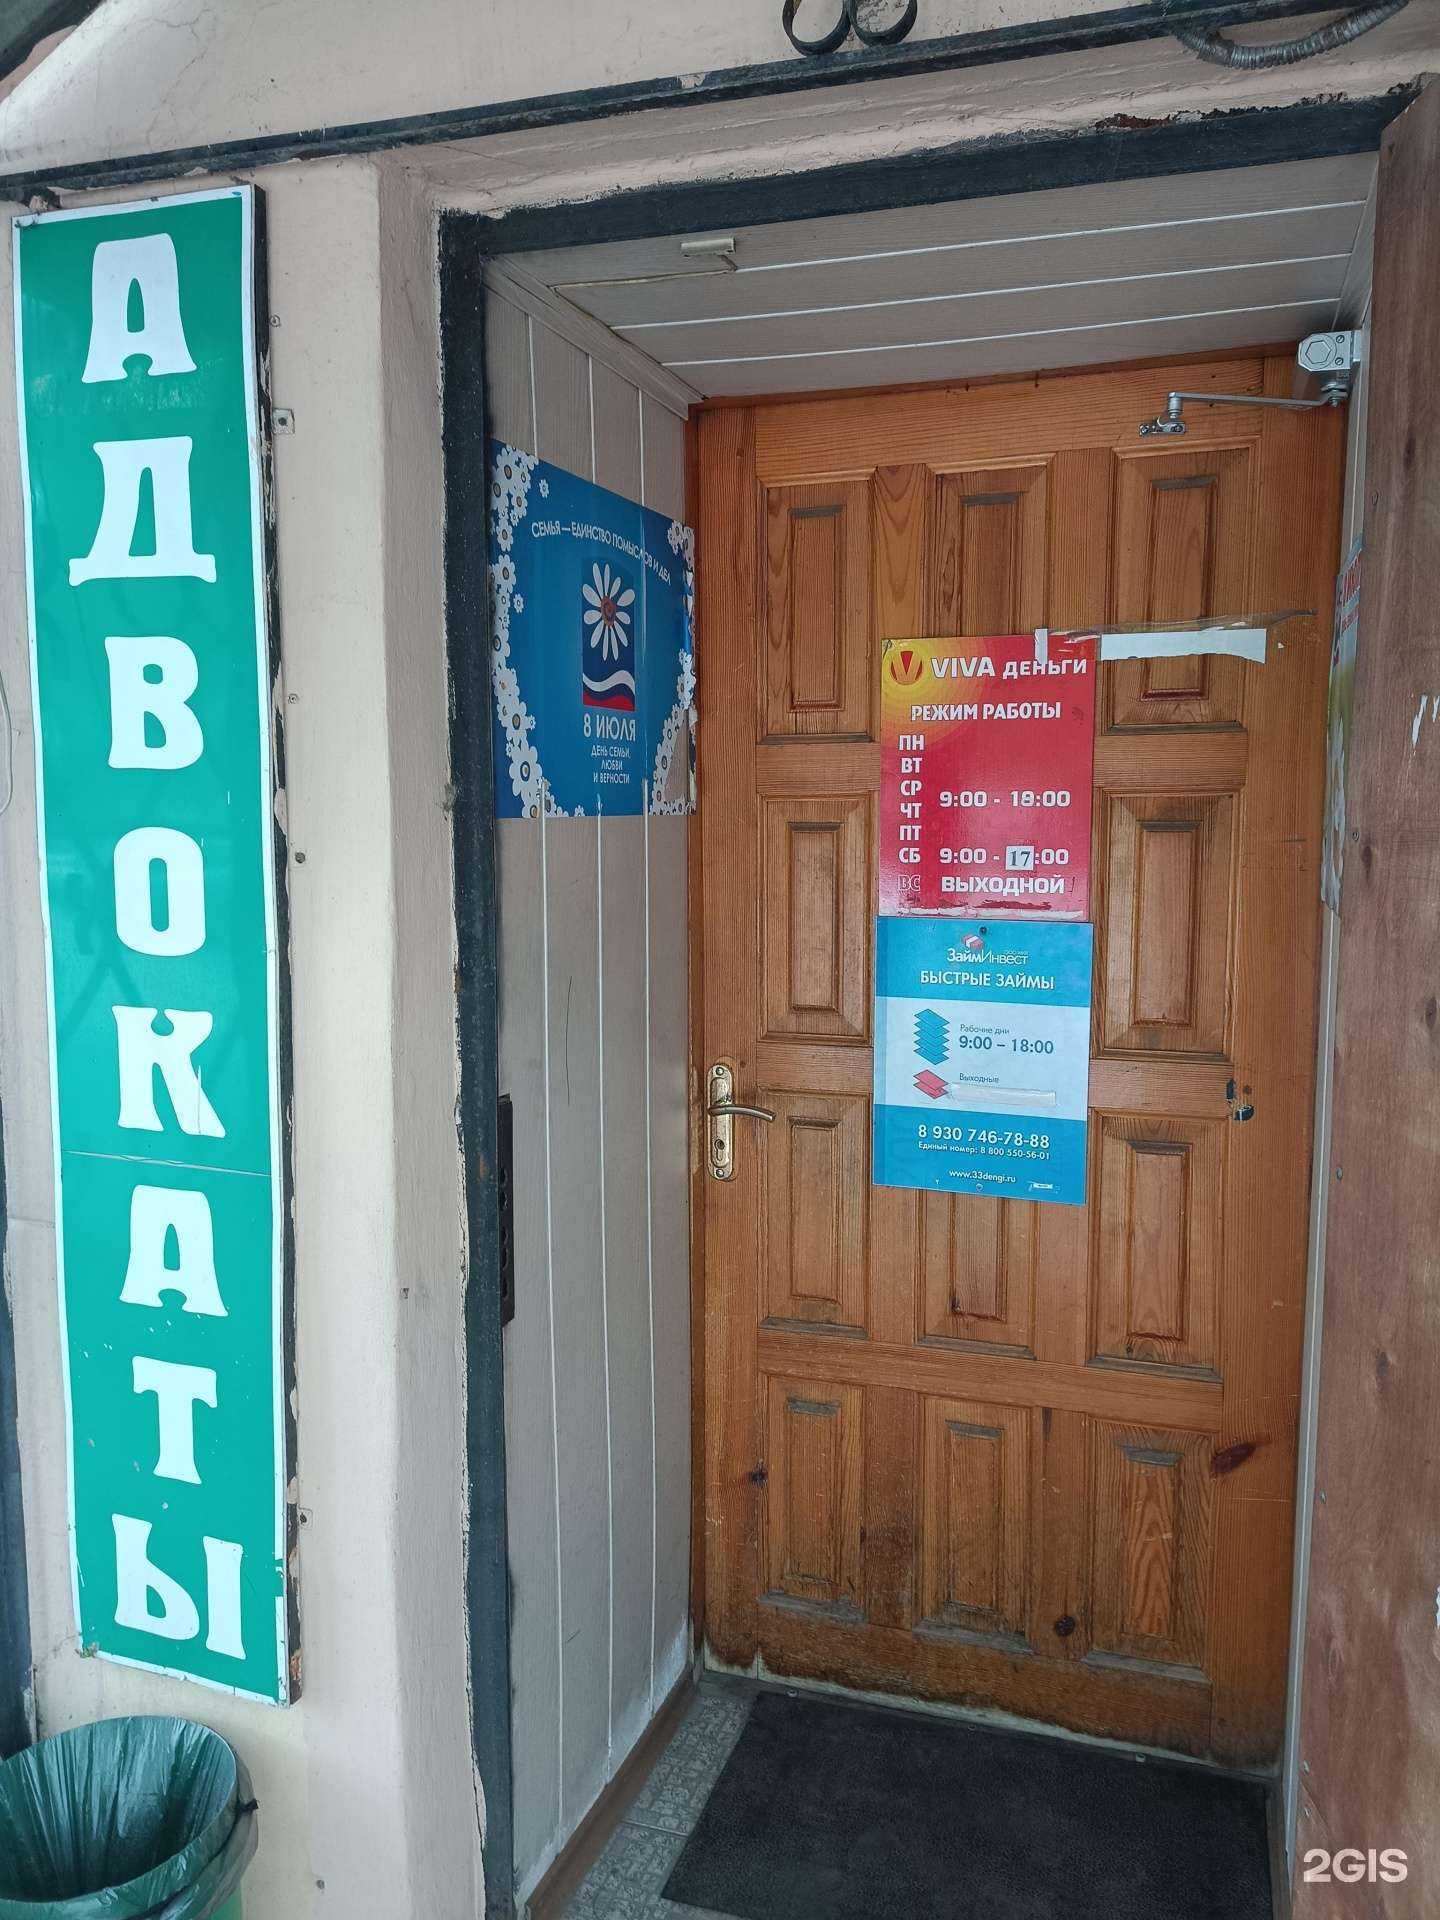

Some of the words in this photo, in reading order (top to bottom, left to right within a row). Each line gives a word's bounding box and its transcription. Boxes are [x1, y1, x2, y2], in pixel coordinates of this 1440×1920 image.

[531, 520, 561, 538] СЕМЬЯ
[571, 521, 613, 544] ЕДИНСТВО
[653, 558, 659, 573] И
[658, 565, 671, 586] ДЕЛ
[931, 656, 996, 678] VIVA
[911, 703, 978, 721] РЕЖИМ
[982, 701, 1061, 719] РАБОТЫ
[583, 713, 592, 738] 8
[596, 714, 636, 741] ИЮЛЯ
[898, 734, 925, 751] ПН
[591, 745, 608, 758] ДЕНЬ
[601, 760, 623, 771] ЛЮБВИ
[901, 757, 923, 774] ВТ
[593, 773, 598, 783] И
[600, 773, 630, 785] ВЕРНОСТИ
[900, 780, 922, 796] СР
[939, 790, 988, 807] 9:00
[900, 802, 922, 819] ЧТ
[899, 824, 922, 841] ПТ
[898, 847, 921, 864] СБ
[939, 847, 987, 864] 9:00
[1007, 848, 1069, 867] 17:00
[897, 874, 921, 892] ВС
[941, 874, 1065, 896] ВЫХОДНОЙ
[68, 232, 248, 1662] АДВОКАТЫ
[920, 970, 991, 986] БЫСТРЫЕ
[995, 972, 1055, 990] ЗАЙМЫ
[959, 1023, 993, 1034] Рабочие
[994, 1026, 1010, 1036] дни
[959, 1035, 993, 1050] 9:00
[1011, 1038, 1054, 1055] 18:00
[959, 1072, 1000, 1084] Выходные
[918, 1124, 927, 1138] 8
[932, 1126, 963, 1141] 930
[968, 1128, 1050, 1149] 746-78-88
[918, 1141, 948, 1152] Единый
[950, 1145, 979, 1156] номер:
[980, 1147, 986, 1155] 8
[988, 1148, 1005, 1156] 800
[1006, 1149, 1051, 1160] 550-56-01
[949, 1169, 1017, 1184] www.33dengi.ru
